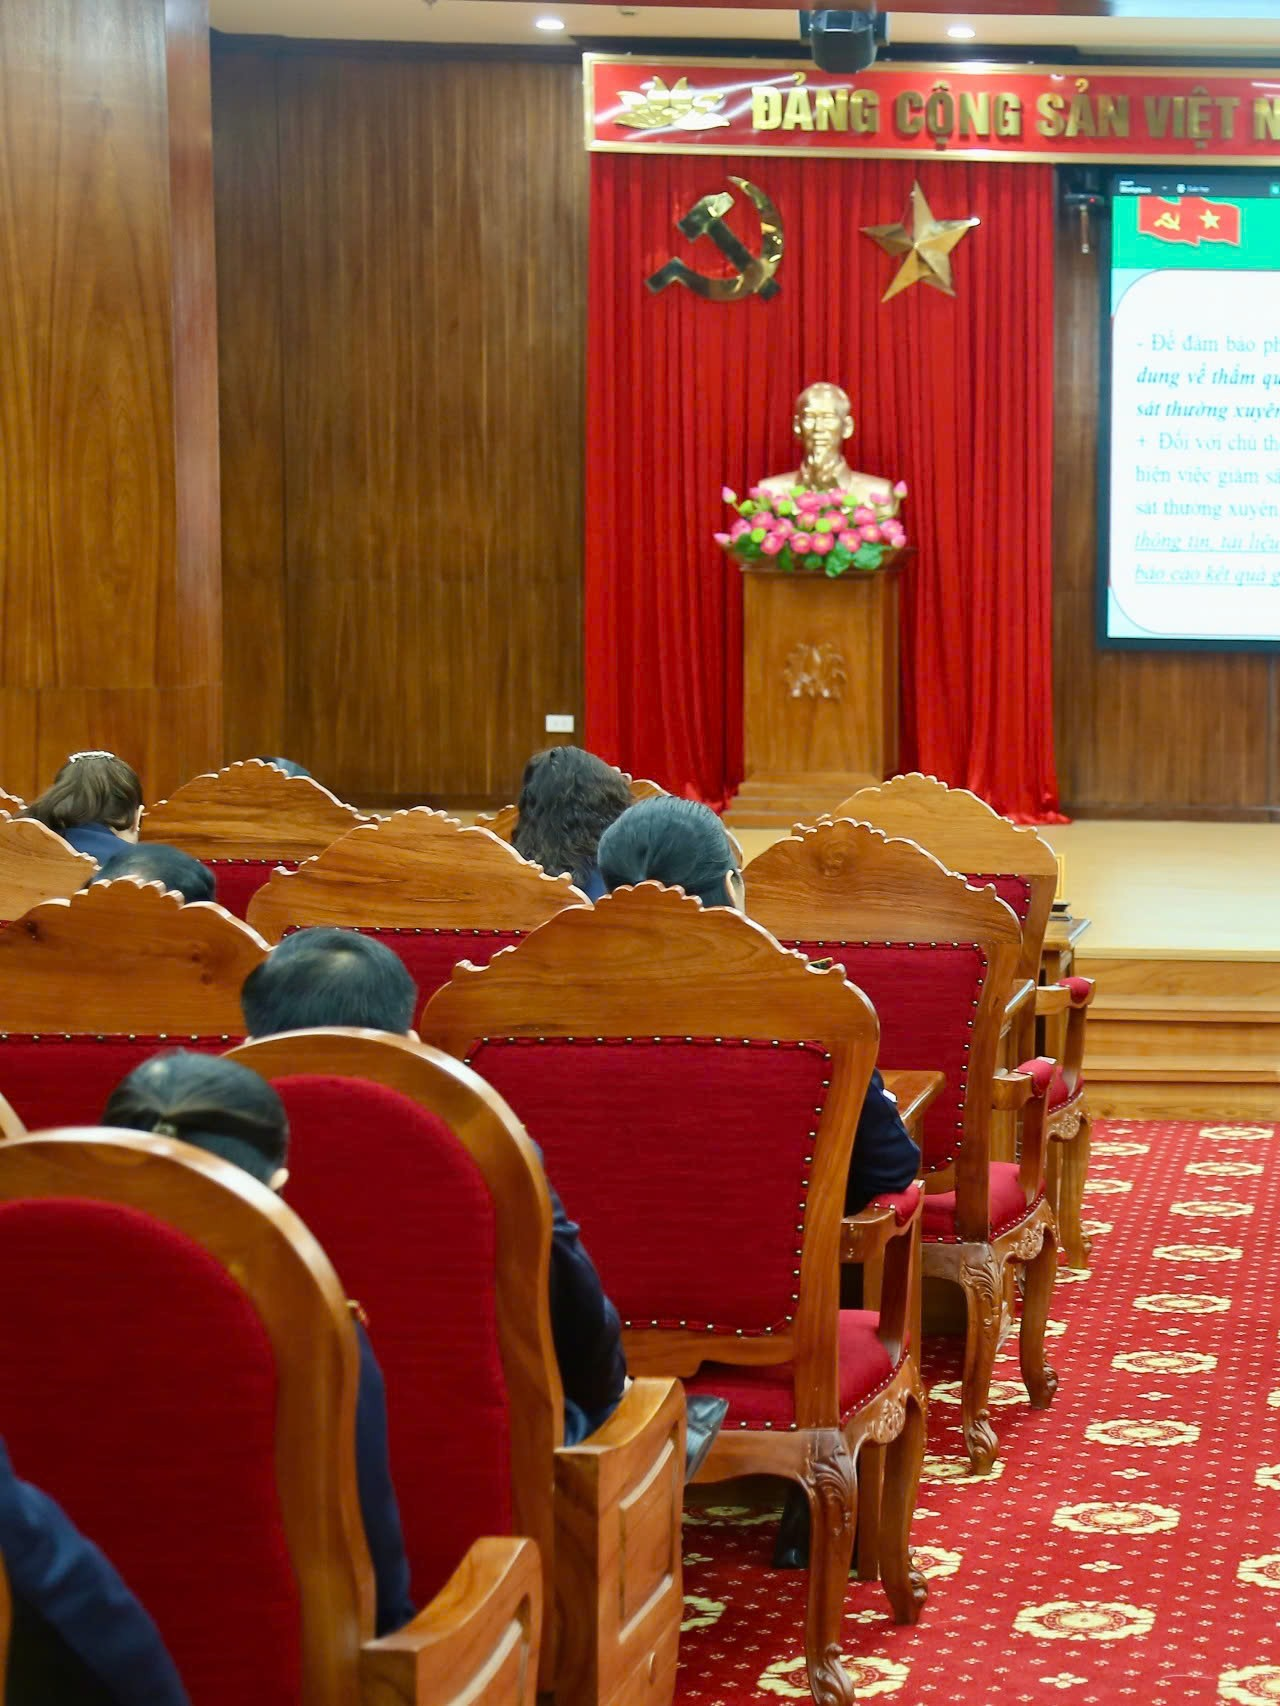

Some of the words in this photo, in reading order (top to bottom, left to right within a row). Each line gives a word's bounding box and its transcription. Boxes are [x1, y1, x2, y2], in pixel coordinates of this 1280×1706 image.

[750, 70, 880, 132] ĐẢNG
[896, 80, 1021, 150] CỘNG
[1035, 77, 1130, 137] SẢN
[1144, 85, 1240, 148] VIỆT
